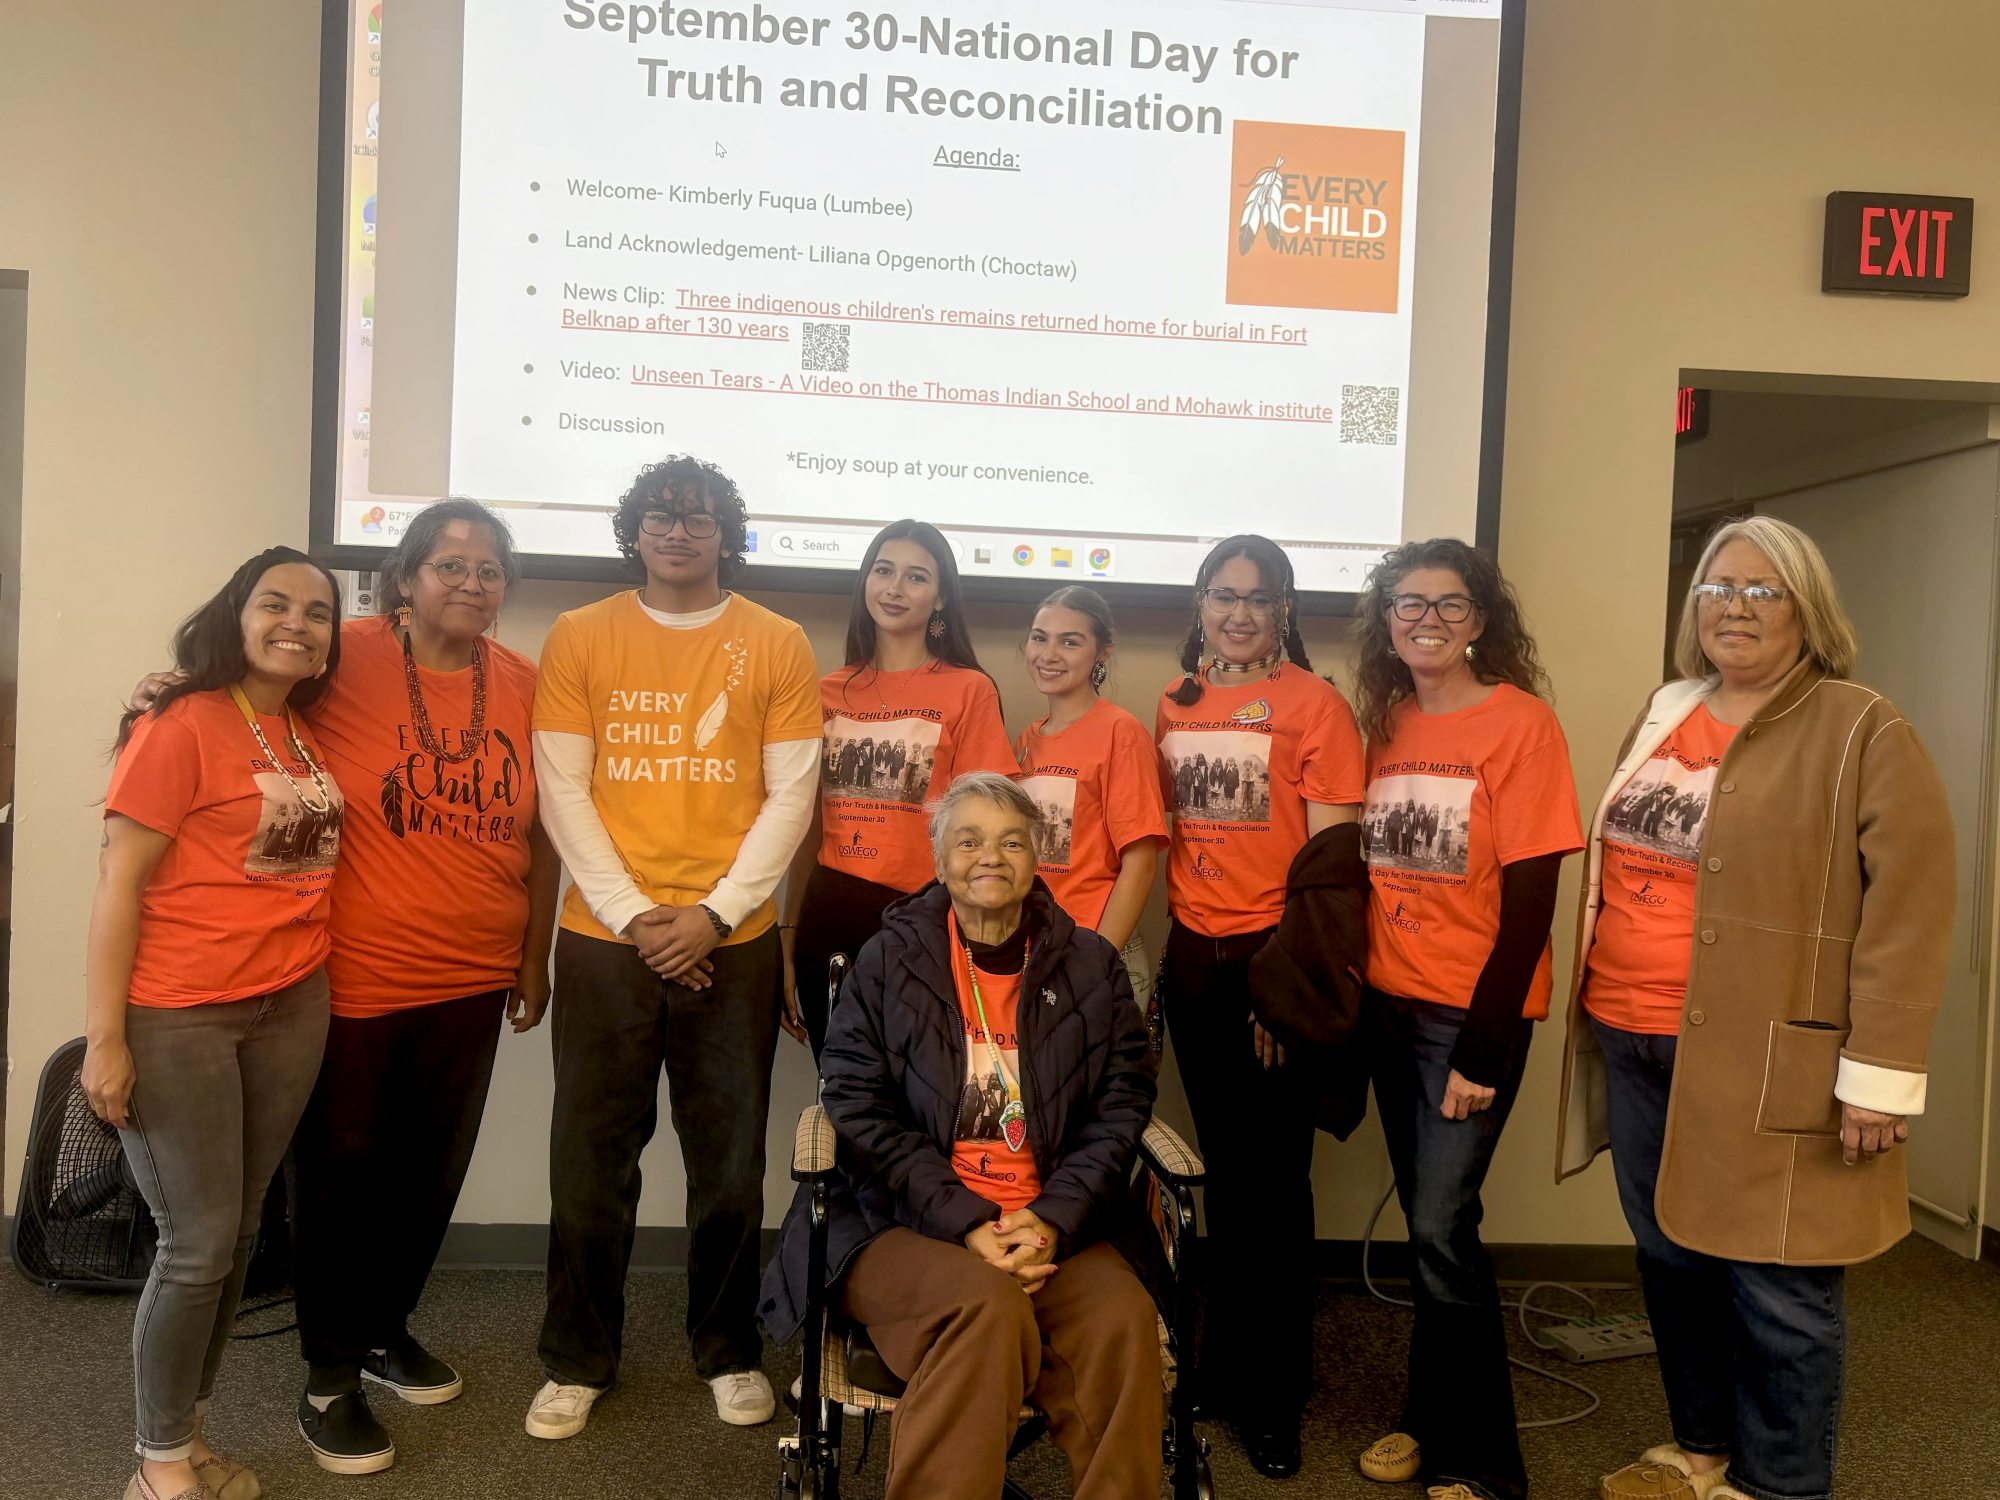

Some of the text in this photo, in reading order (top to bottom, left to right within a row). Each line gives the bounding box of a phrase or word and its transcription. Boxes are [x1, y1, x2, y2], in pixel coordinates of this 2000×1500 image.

[563, 0, 1299, 84] September 30-National Day for
[637, 58, 1223, 134] Truth and Reconciliation
[933, 145, 1020, 171] Agenda:
[567, 178, 914, 220] Welcome- Kimberly Fuqua (Lumbee)
[1280, 173, 1387, 206] EVERY
[1278, 203, 1387, 238] CHILD
[1279, 236, 1387, 260] MATTERS
[1859, 207, 1954, 279] EXIT
[565, 230, 1077, 282] Land Acknowledgement- Liliana Opgenorth (Choctaw)
[563, 282, 1308, 343] News Clip: Three indigenous children's remains returned home for burial in Fort
[562, 308, 789, 343] Belknap after 130 years
[560, 359, 621, 381] Video:
[632, 364, 704, 386] Unseen
[710, 368, 763, 390] Tears
[779, 373, 795, 391] A
[799, 374, 854, 396] Video
[858, 380, 882, 397] on
[887, 378, 918, 399] the
[924, 380, 1000, 405] Thomas
[1005, 386, 1062, 408] Indian
[1066, 390, 1131, 411] School
[1136, 394, 1170, 413] and
[1175, 395, 1253, 416] Mohawk
[1259, 401, 1333, 422] institute
[1676, 387, 1694, 433] XIT
[558, 412, 665, 436] Discussion
[852, 457, 898, 478] soup
[904, 460, 923, 476] at
[928, 462, 969, 484] your
[973, 464, 1094, 486] convenience.
[802, 539, 840, 552] Search
[608, 690, 688, 714] EVERY
[858, 711, 891, 720] CHILD
[893, 708, 943, 720] MATTERS
[606, 722, 682, 745] CHILD
[1188, 721, 1220, 729] CHILD
[1222, 720, 1273, 733] MATTERS
[607, 756, 736, 783] MATTERS
[1379, 763, 1400, 776] EVERY
[1401, 761, 1427, 772] CHILD
[405, 753, 521, 813] Child
[855, 801, 874, 810] Truth
[408, 801, 515, 842] MATTERS
[838, 813, 876, 823] September
[1218, 824, 1270, 832] Reconciliation
[839, 845, 878, 857] OSWEGO
[1183, 835, 1225, 845] eptember 30
[1639, 850, 1658, 862] Truth
[1659, 856, 1664, 864] &
[306, 872, 330, 883] Truth
[1375, 869, 1390, 878] Day
[1621, 862, 1663, 877] September
[1385, 911, 1421, 931] SWEGO
